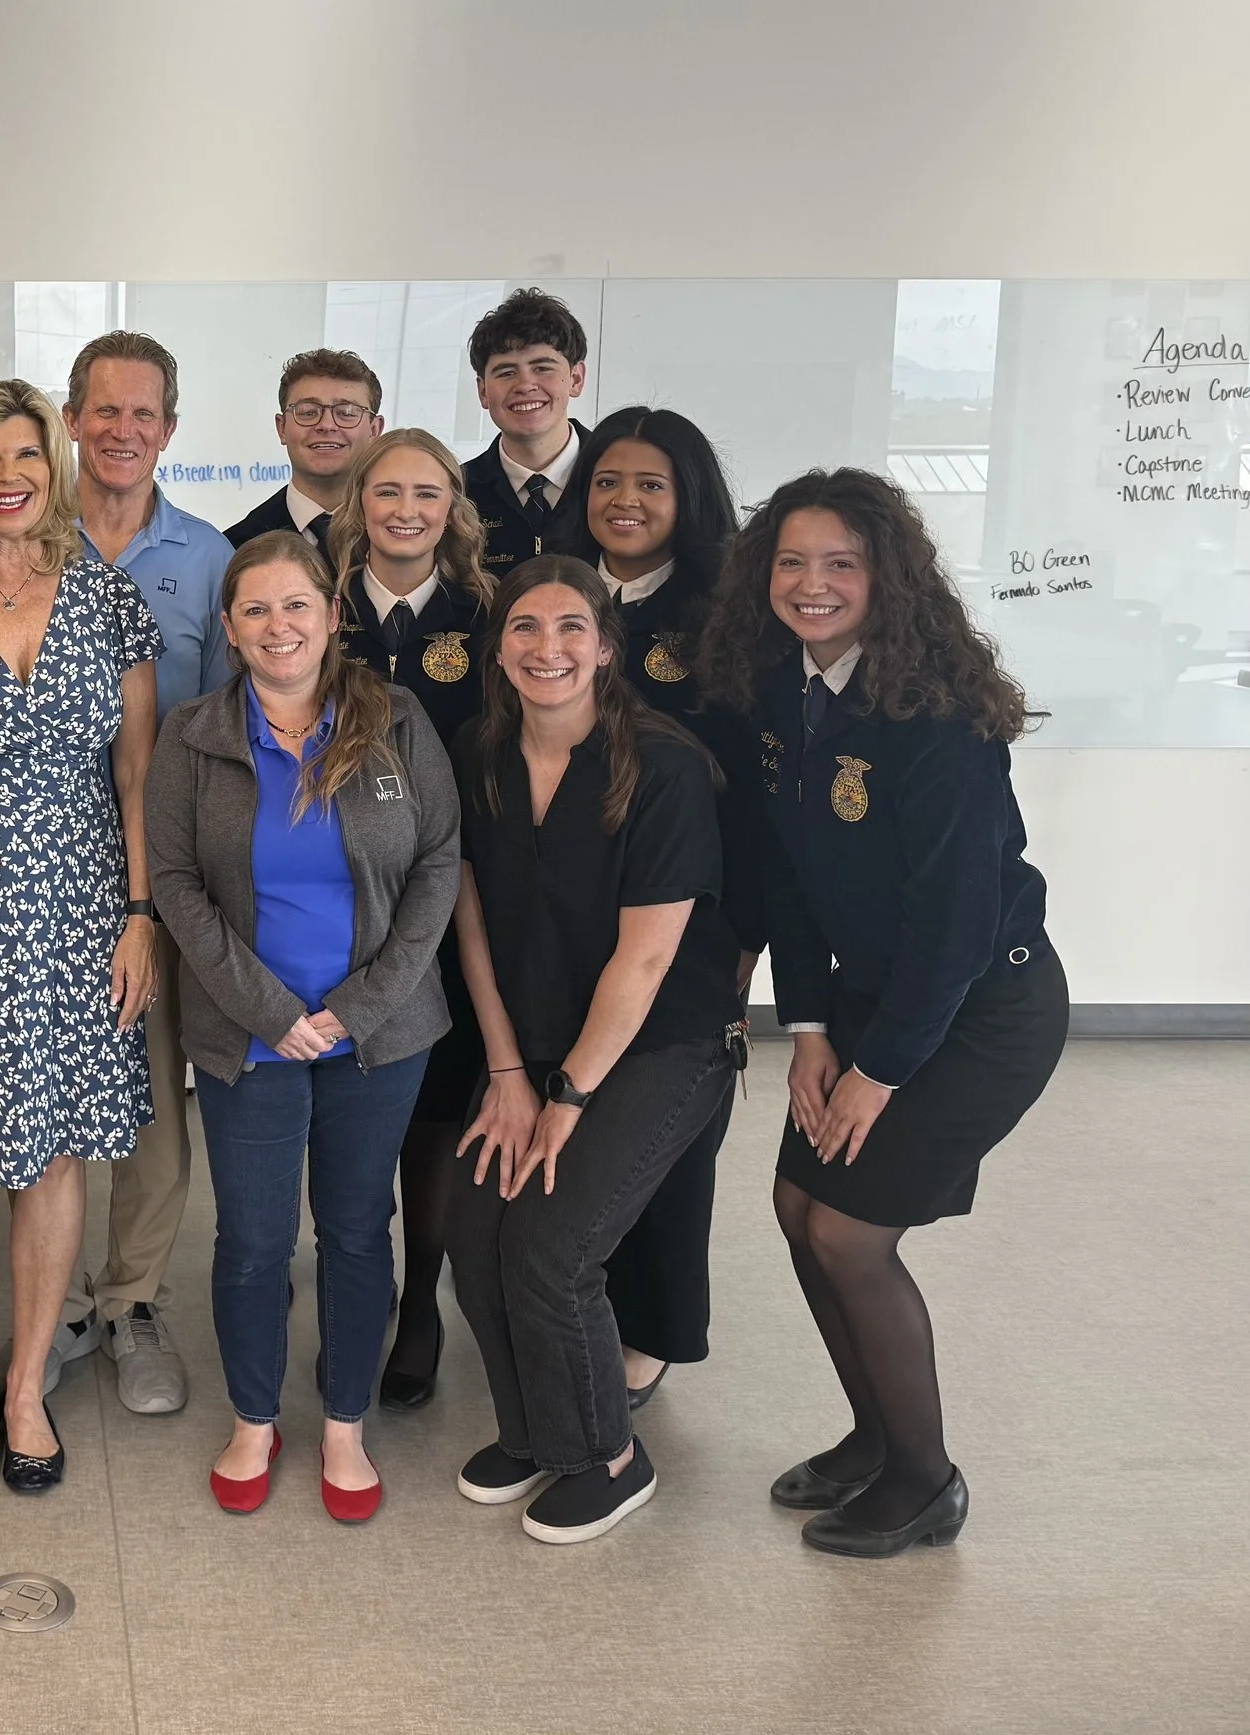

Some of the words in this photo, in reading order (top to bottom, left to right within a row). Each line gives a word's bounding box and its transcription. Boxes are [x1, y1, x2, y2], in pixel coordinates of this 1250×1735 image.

[1142, 327, 1248, 374] Agenda
[1124, 379, 1191, 409] Review
[1126, 418, 1192, 442] Lunch
[173, 463, 243, 491] Breaking
[249, 462, 291, 482] down
[1125, 454, 1203, 479] Capstone
[1123, 485, 1175, 502] MCMC
[1187, 482, 1250, 509] Meeting
[1043, 548, 1090, 570] Green
[1047, 577, 1093, 594] Santos
[375, 790, 396, 801] MFF
